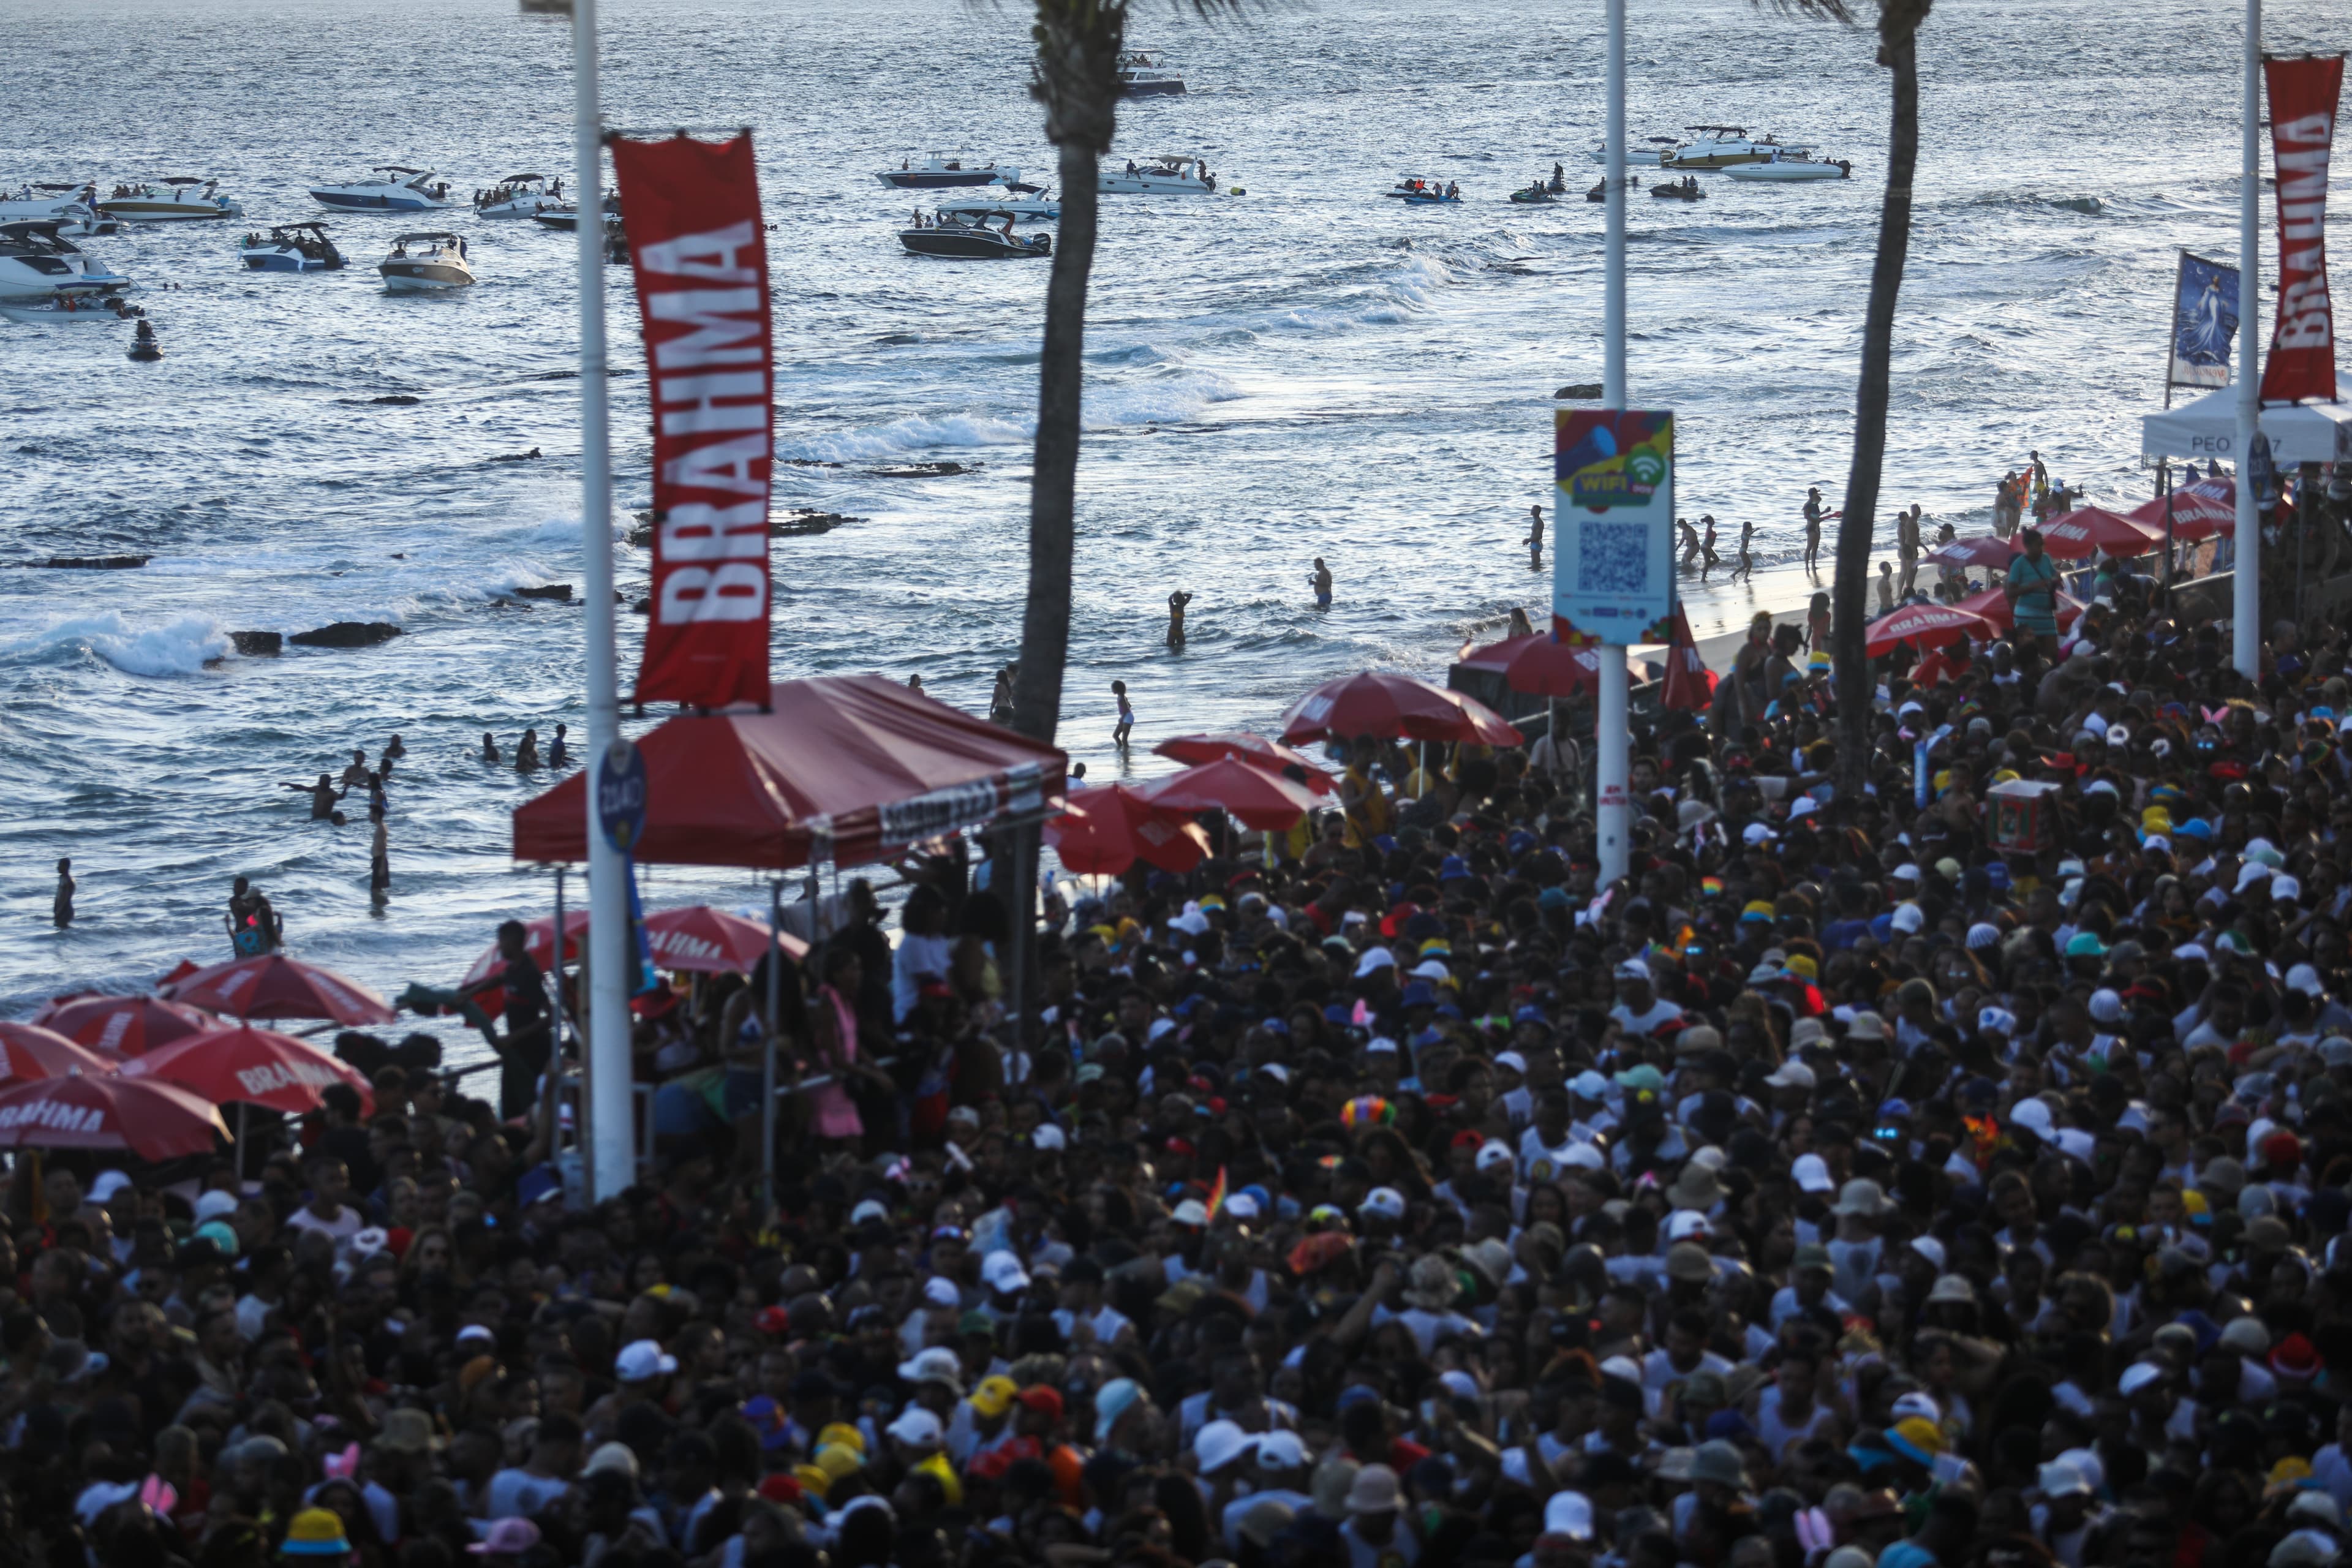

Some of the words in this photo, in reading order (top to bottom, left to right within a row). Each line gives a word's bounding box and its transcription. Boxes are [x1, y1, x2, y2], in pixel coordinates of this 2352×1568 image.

[2274, 112, 2330, 350] BRAHMA
[639, 219, 767, 625] BRAHMA
[2192, 437, 2230, 452] PEO
[1581, 475, 1627, 492] WIFI
[1889, 613, 1959, 632] BRAHMA
